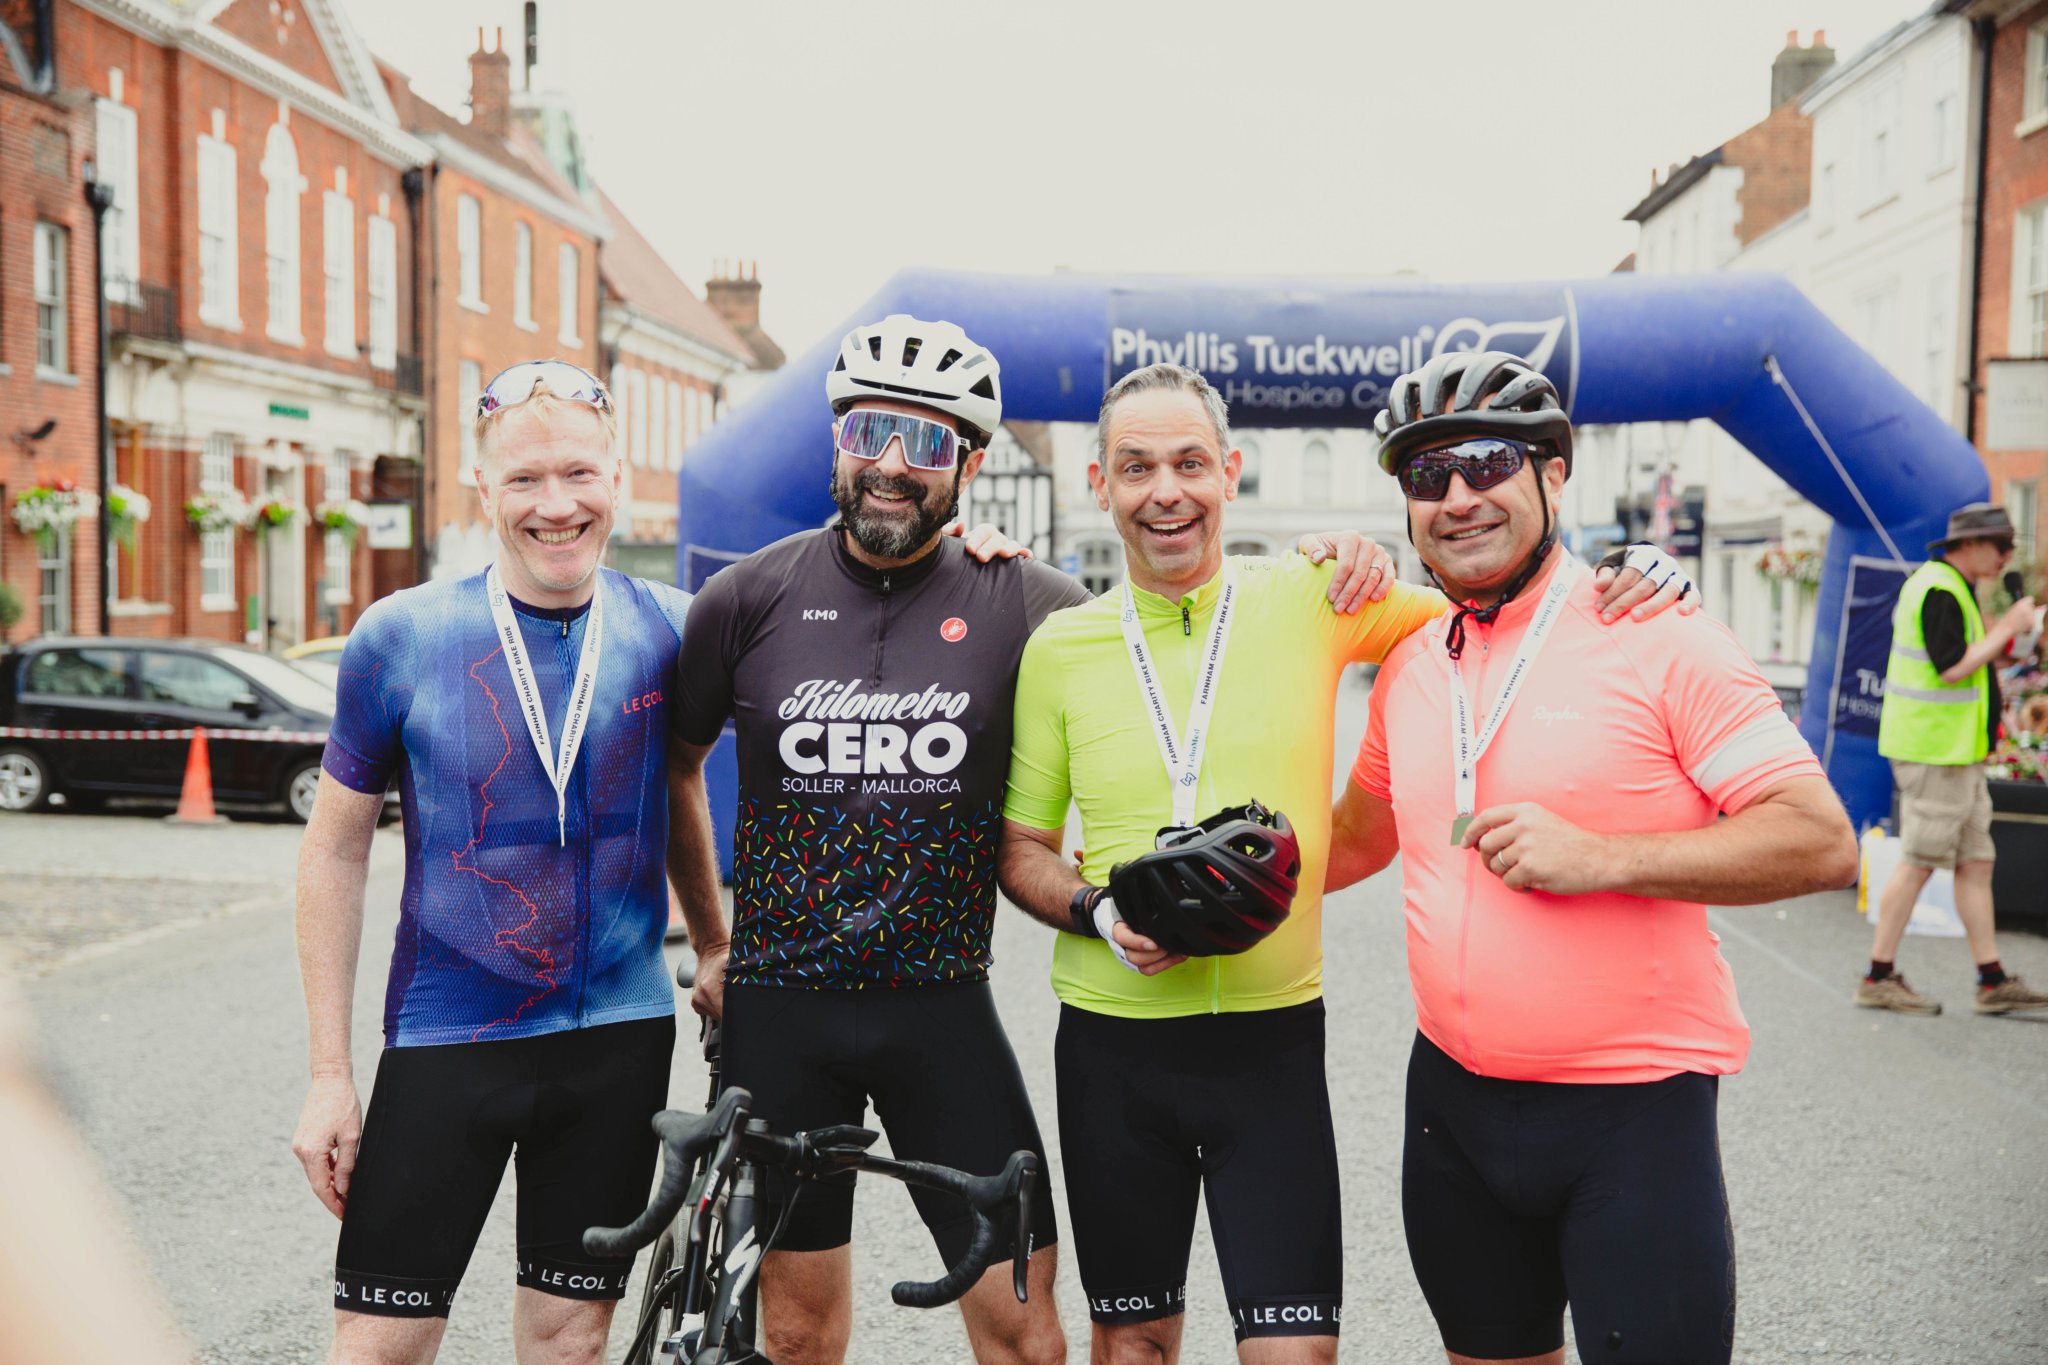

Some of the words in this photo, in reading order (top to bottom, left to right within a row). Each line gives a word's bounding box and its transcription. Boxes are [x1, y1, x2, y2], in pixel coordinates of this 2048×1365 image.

[1112, 327, 1239, 374] Phyllis
[1245, 334, 1422, 375] Tuckwell
[1226, 380, 1345, 411] Hospice
[1350, 380, 1394, 407] Ca
[503, 625, 515, 646] RIDE
[1134, 643, 1145, 663] RIDE
[1200, 663, 1215, 705] FARNHAM
[1210, 625, 1224, 661] CHARITY
[1219, 604, 1229, 624] BIKE
[1224, 583, 1233, 603] RIDE
[510, 645, 522, 665] BIKE
[516, 667, 534, 704] CHARITY
[1141, 664, 1152, 685] BIKE
[1503, 658, 1526, 699] FARNHAM
[576, 673, 591, 715] FARNHAM
[622, 697, 641, 714] LE
[642, 691, 664, 708] COL
[778, 678, 971, 721] Kilometro
[1148, 685, 1165, 722] CHARITY
[528, 704, 546, 746] FARNHAM
[566, 713, 582, 750] CHARITY
[1457, 694, 1467, 735] FARNHAM
[778, 721, 968, 775] CERO
[1160, 723, 1179, 764] FARNHAM
[782, 777, 845, 793] SOLLER
[861, 778, 962, 793] MALLORCA
[335, 1282, 349, 1298] OL
[361, 1285, 386, 1304] LE
[391, 1290, 433, 1307] COL
[541, 1268, 564, 1286] LE
[568, 1275, 607, 1290] COL
[1092, 1298, 1113, 1313] LE
[1115, 1295, 1156, 1312] COL
[1253, 1306, 1277, 1324] LE
[1281, 1305, 1323, 1323] COL
